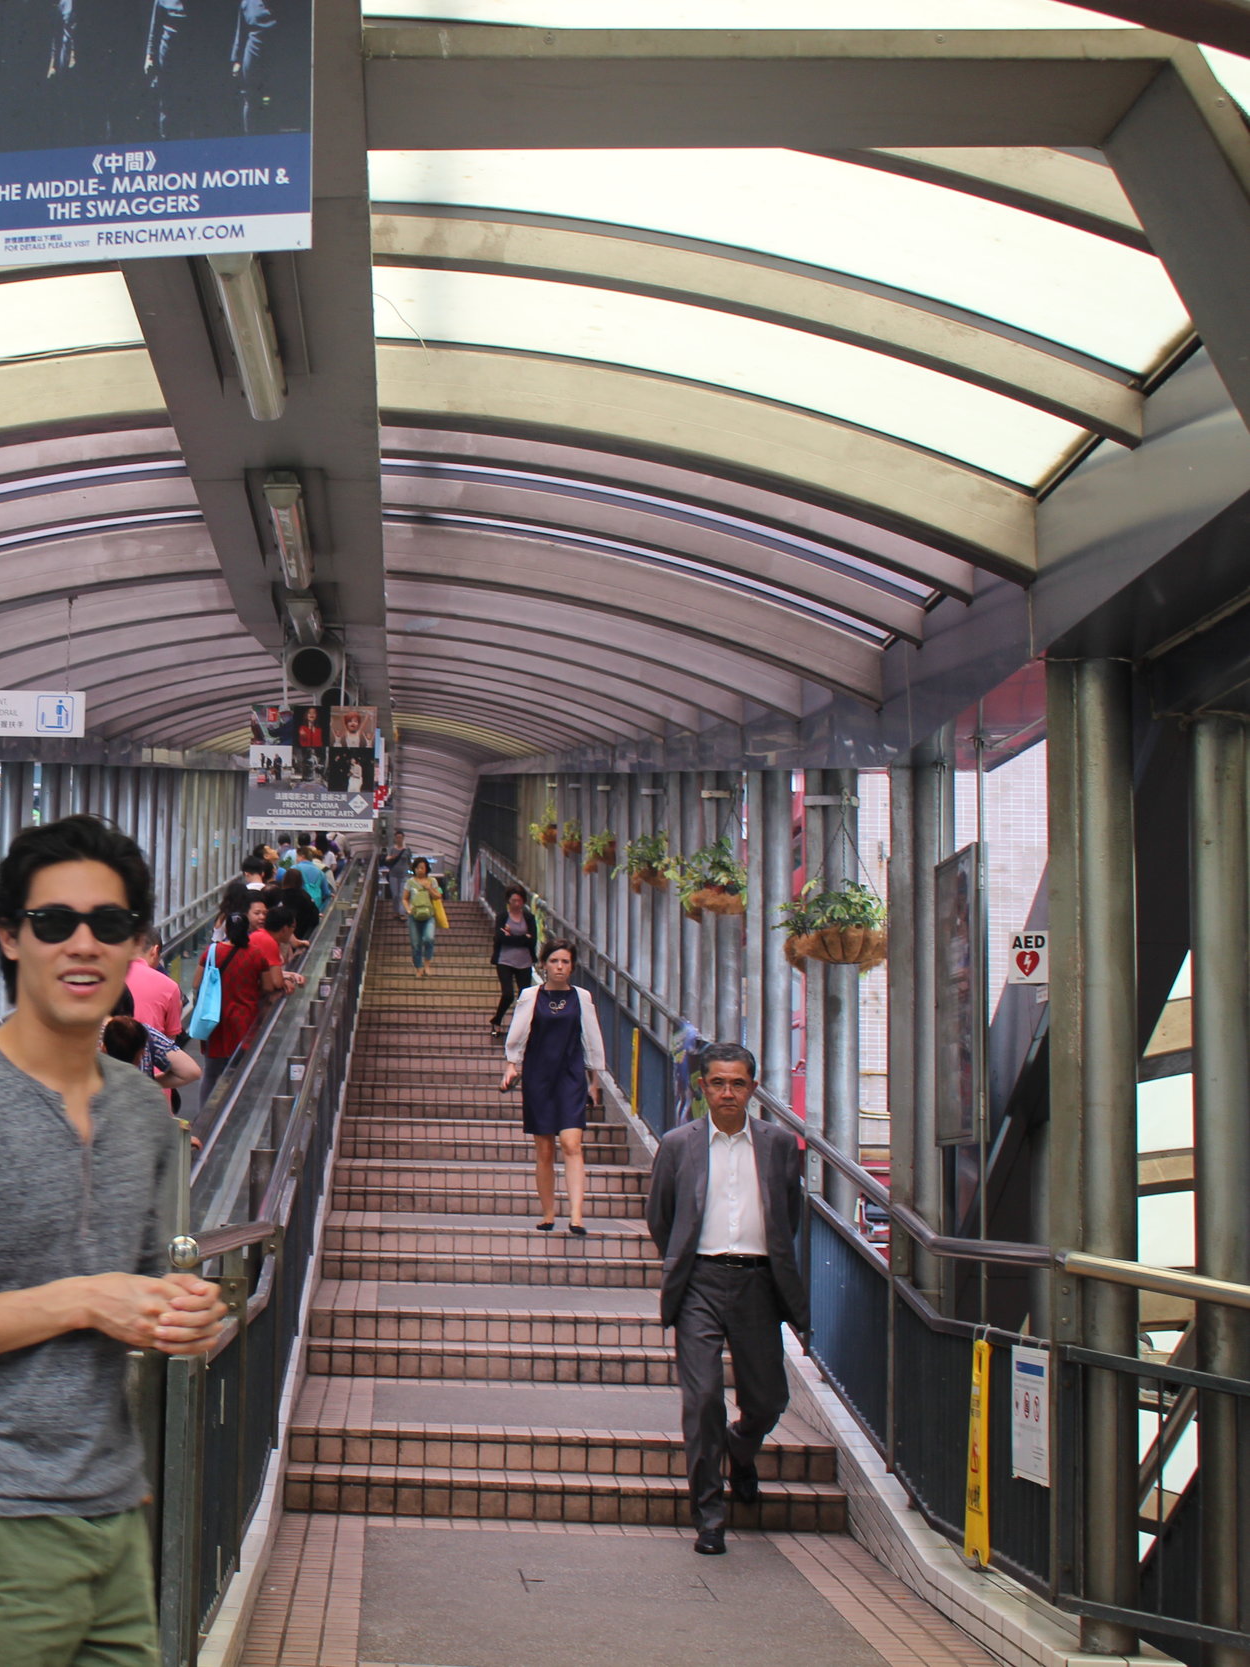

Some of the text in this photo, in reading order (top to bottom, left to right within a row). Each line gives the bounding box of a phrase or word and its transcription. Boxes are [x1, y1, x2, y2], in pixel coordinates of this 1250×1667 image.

[92, 150, 157, 174] 《中間》
[26, 178, 106, 200] MIDDLE-
[111, 172, 197, 194] MARION
[202, 168, 269, 188] MOTIN
[275, 168, 290, 185] &
[48, 194, 200, 220] THE SWAGGERS
[97, 224, 245, 246] FRENCHMAY.COM
[4, 244, 18, 252] FOR
[20, 243, 46, 251] DETAILS
[48, 240, 72, 249] PLEASE
[282, 801, 310, 809] FRENCH
[267, 808, 312, 817] CELEBRATION
[338, 810, 355, 818] ARTS
[319, 821, 369, 829] FRENCHMAY.COM
[1012, 935, 1045, 949] AED
